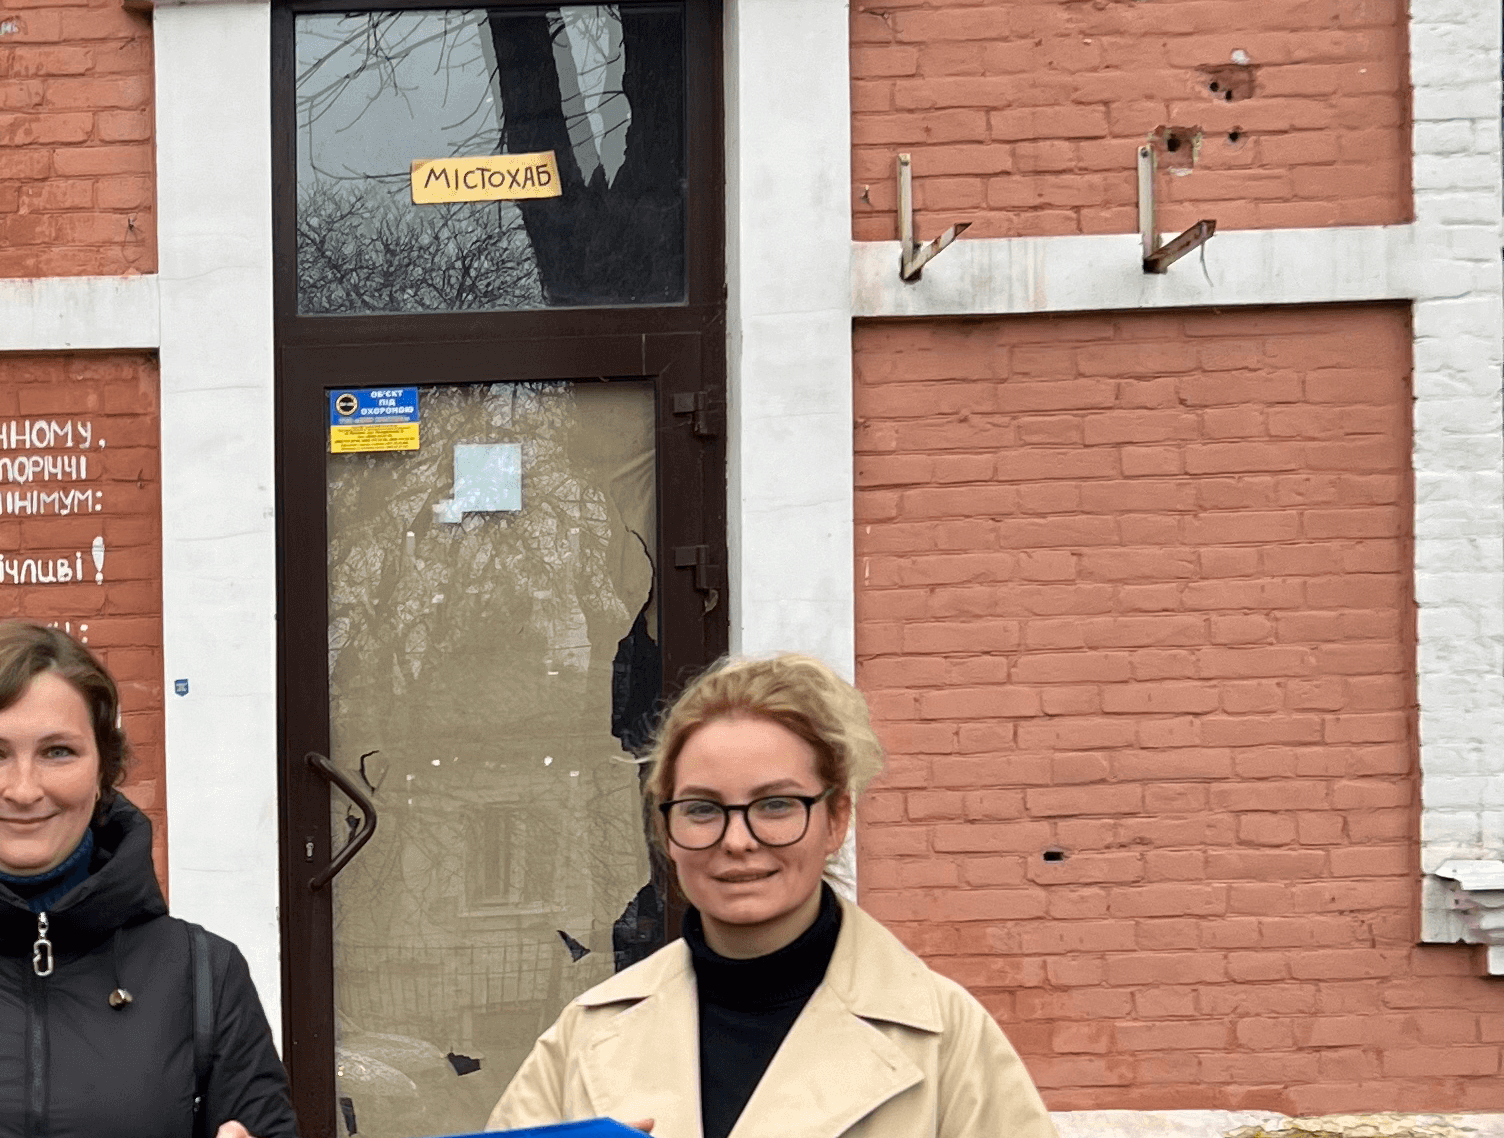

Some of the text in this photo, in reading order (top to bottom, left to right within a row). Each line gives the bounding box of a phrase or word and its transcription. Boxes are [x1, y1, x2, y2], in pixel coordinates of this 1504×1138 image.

[423, 163, 552, 191] МІСТОХАБ
[378, 398, 396, 407] ПІД
[360, 406, 415, 416] ОХОРОНОЮ
